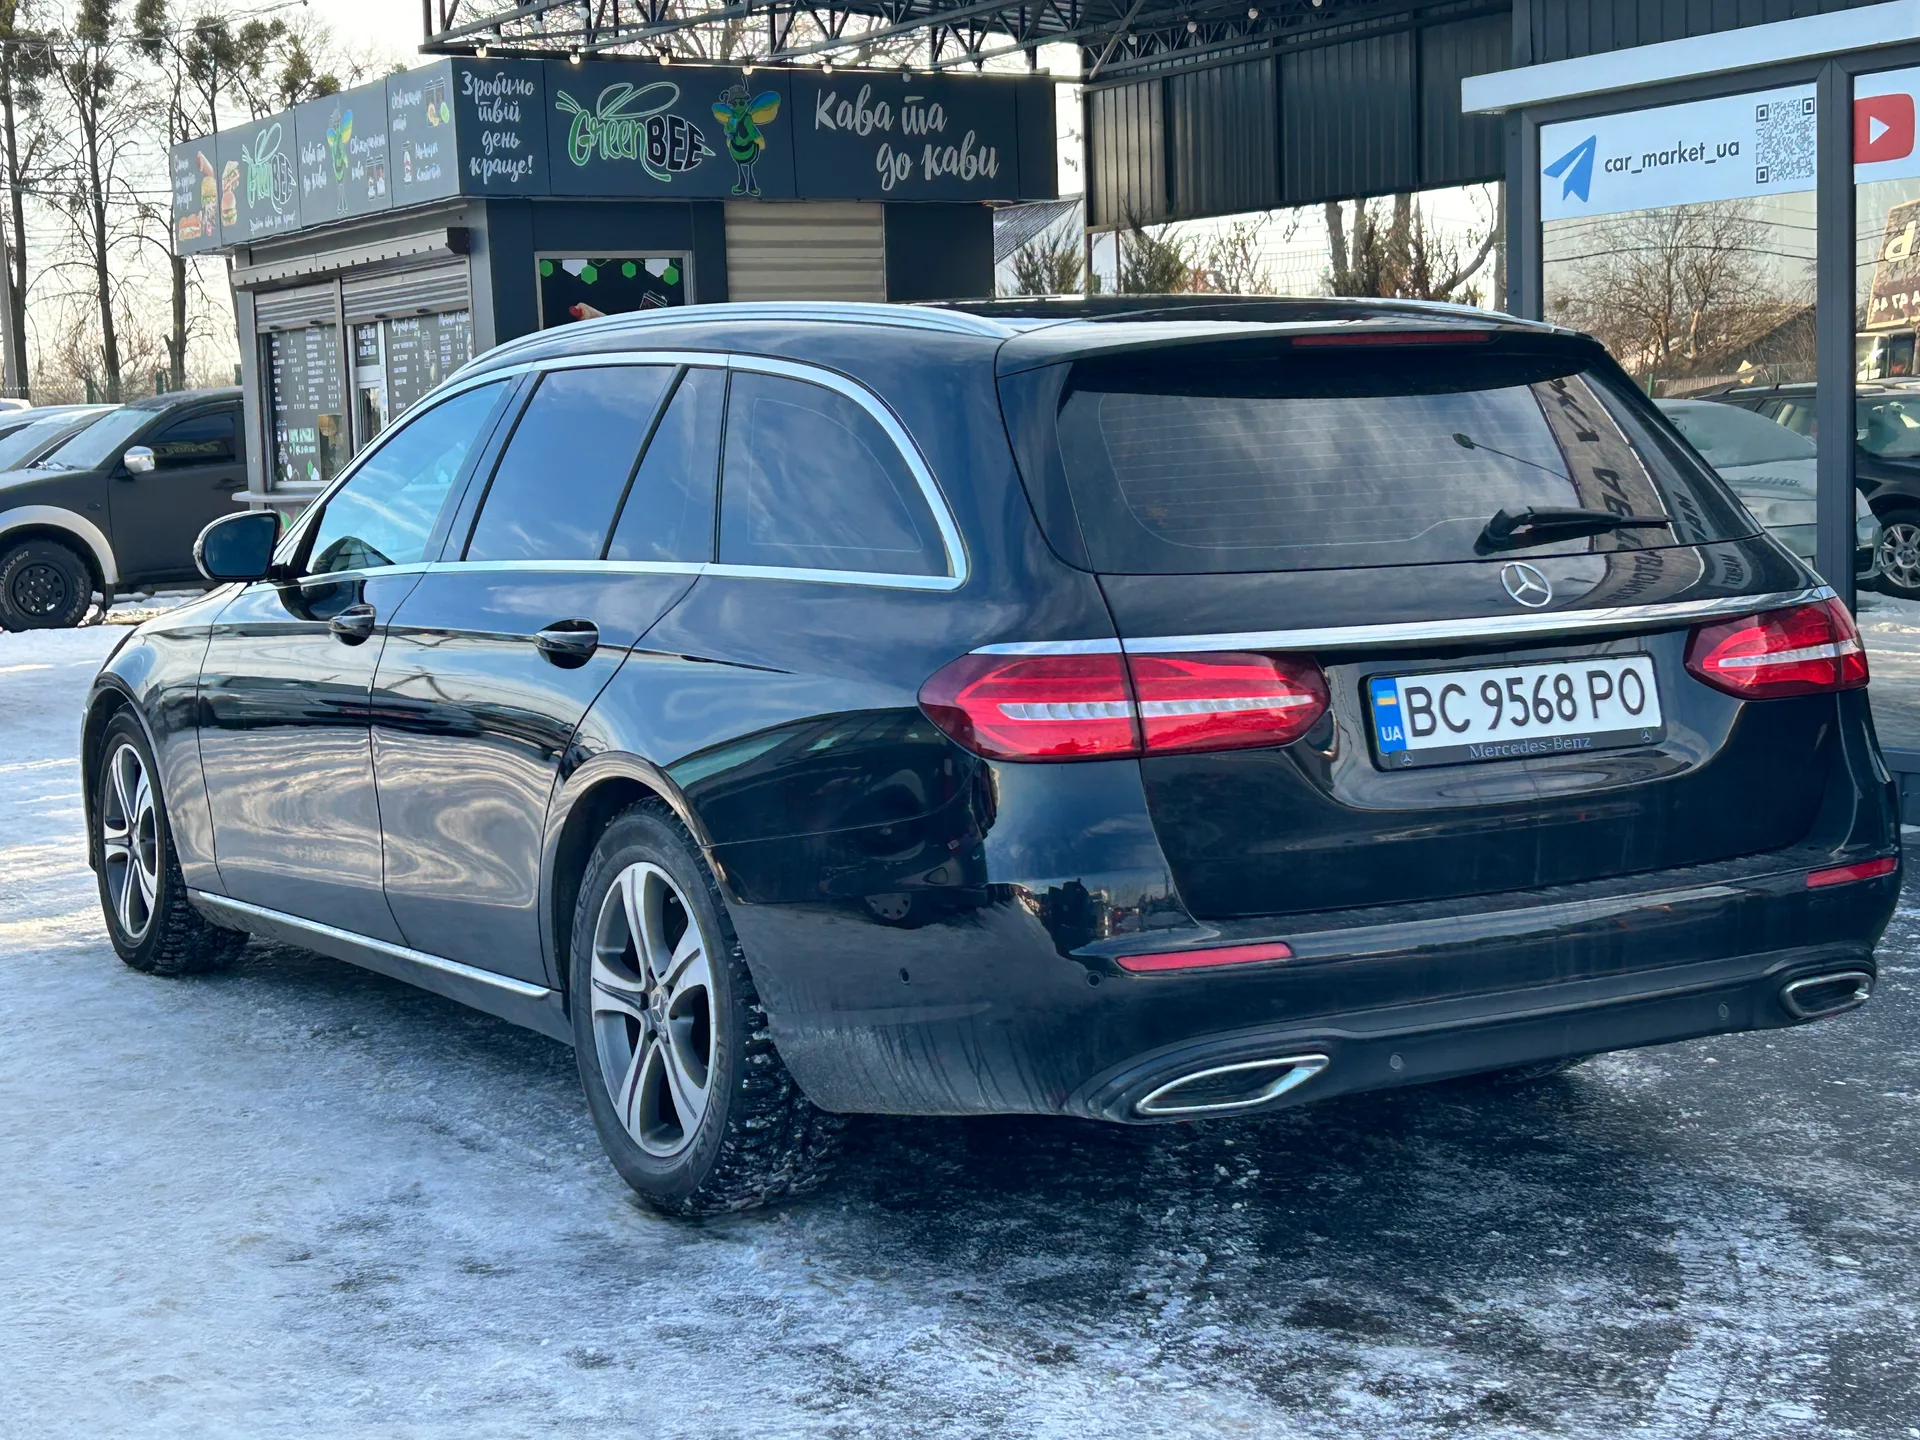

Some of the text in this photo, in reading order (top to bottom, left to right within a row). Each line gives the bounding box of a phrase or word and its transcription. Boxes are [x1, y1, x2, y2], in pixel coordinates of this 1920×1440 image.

[461, 70, 534, 104] Зробимо
[478, 98, 521, 123] твій
[815, 84, 948, 137] Кава та
[481, 130, 521, 156] день
[1604, 139, 1740, 175] car_market_ua
[469, 155, 534, 185] краще!
[875, 130, 1000, 191] до кави
[1405, 667, 1646, 737] BC 9568 PO
[1381, 726, 1404, 742] UA
[1469, 736, 1592, 759] Mercedes-Benz
